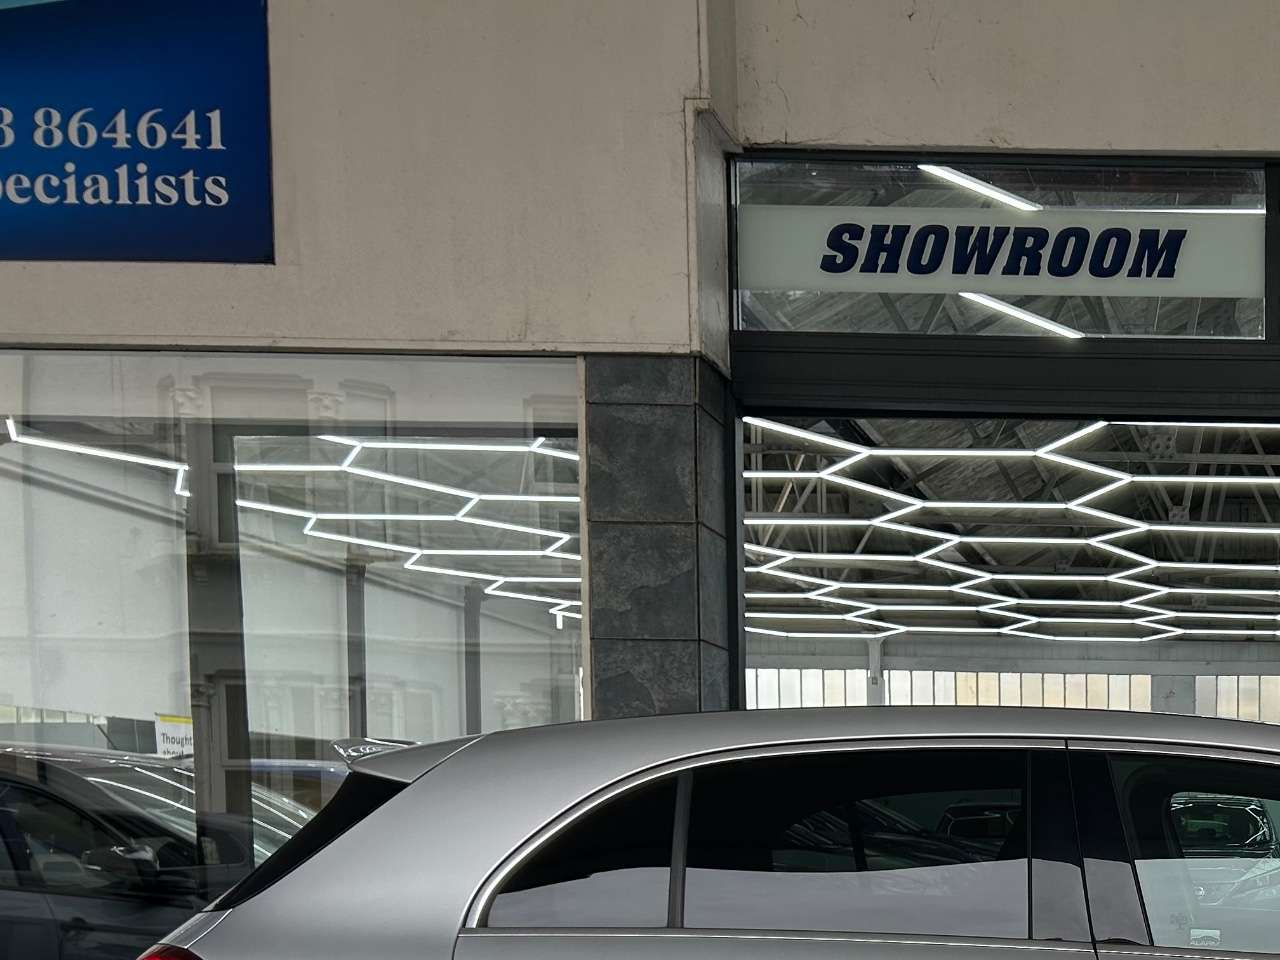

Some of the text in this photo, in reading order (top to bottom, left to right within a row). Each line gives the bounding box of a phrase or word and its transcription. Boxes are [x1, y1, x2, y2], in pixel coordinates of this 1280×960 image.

[33, 107, 227, 150] 864641
[0, 162, 230, 207] ecialists
[819, 222, 1188, 279] SHOWROOM
[161, 733, 193, 748] Thought
